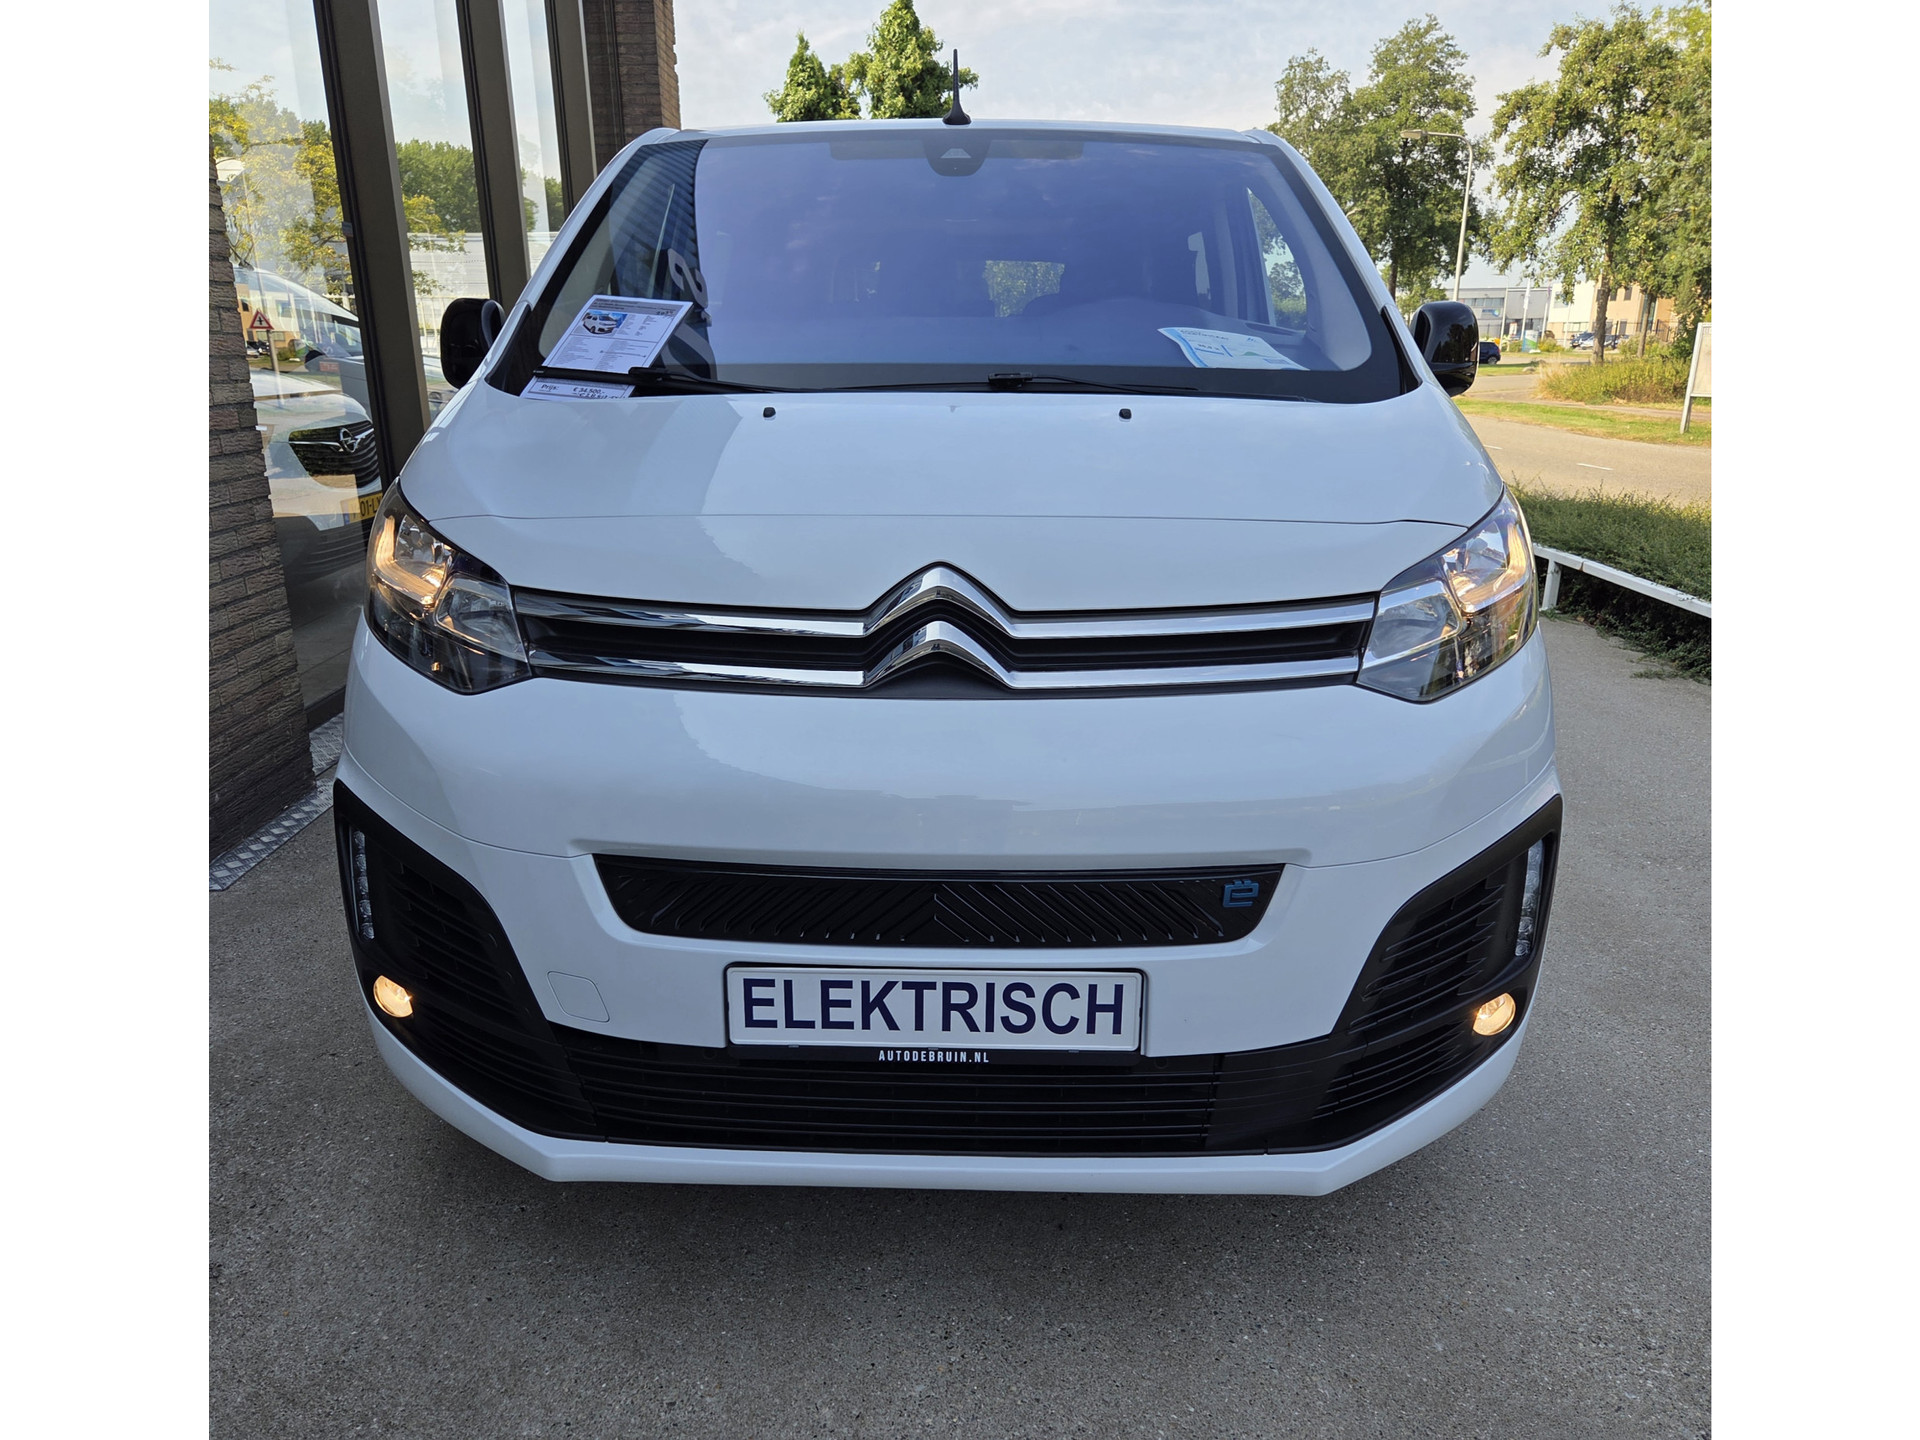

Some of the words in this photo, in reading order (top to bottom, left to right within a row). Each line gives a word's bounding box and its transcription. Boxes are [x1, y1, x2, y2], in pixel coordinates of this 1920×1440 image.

[541, 384, 559, 392] Prijs:
[743, 977, 1124, 1035] ELEKTRISCH
[878, 1049, 990, 1064] AUTODEBRUIN.NL
